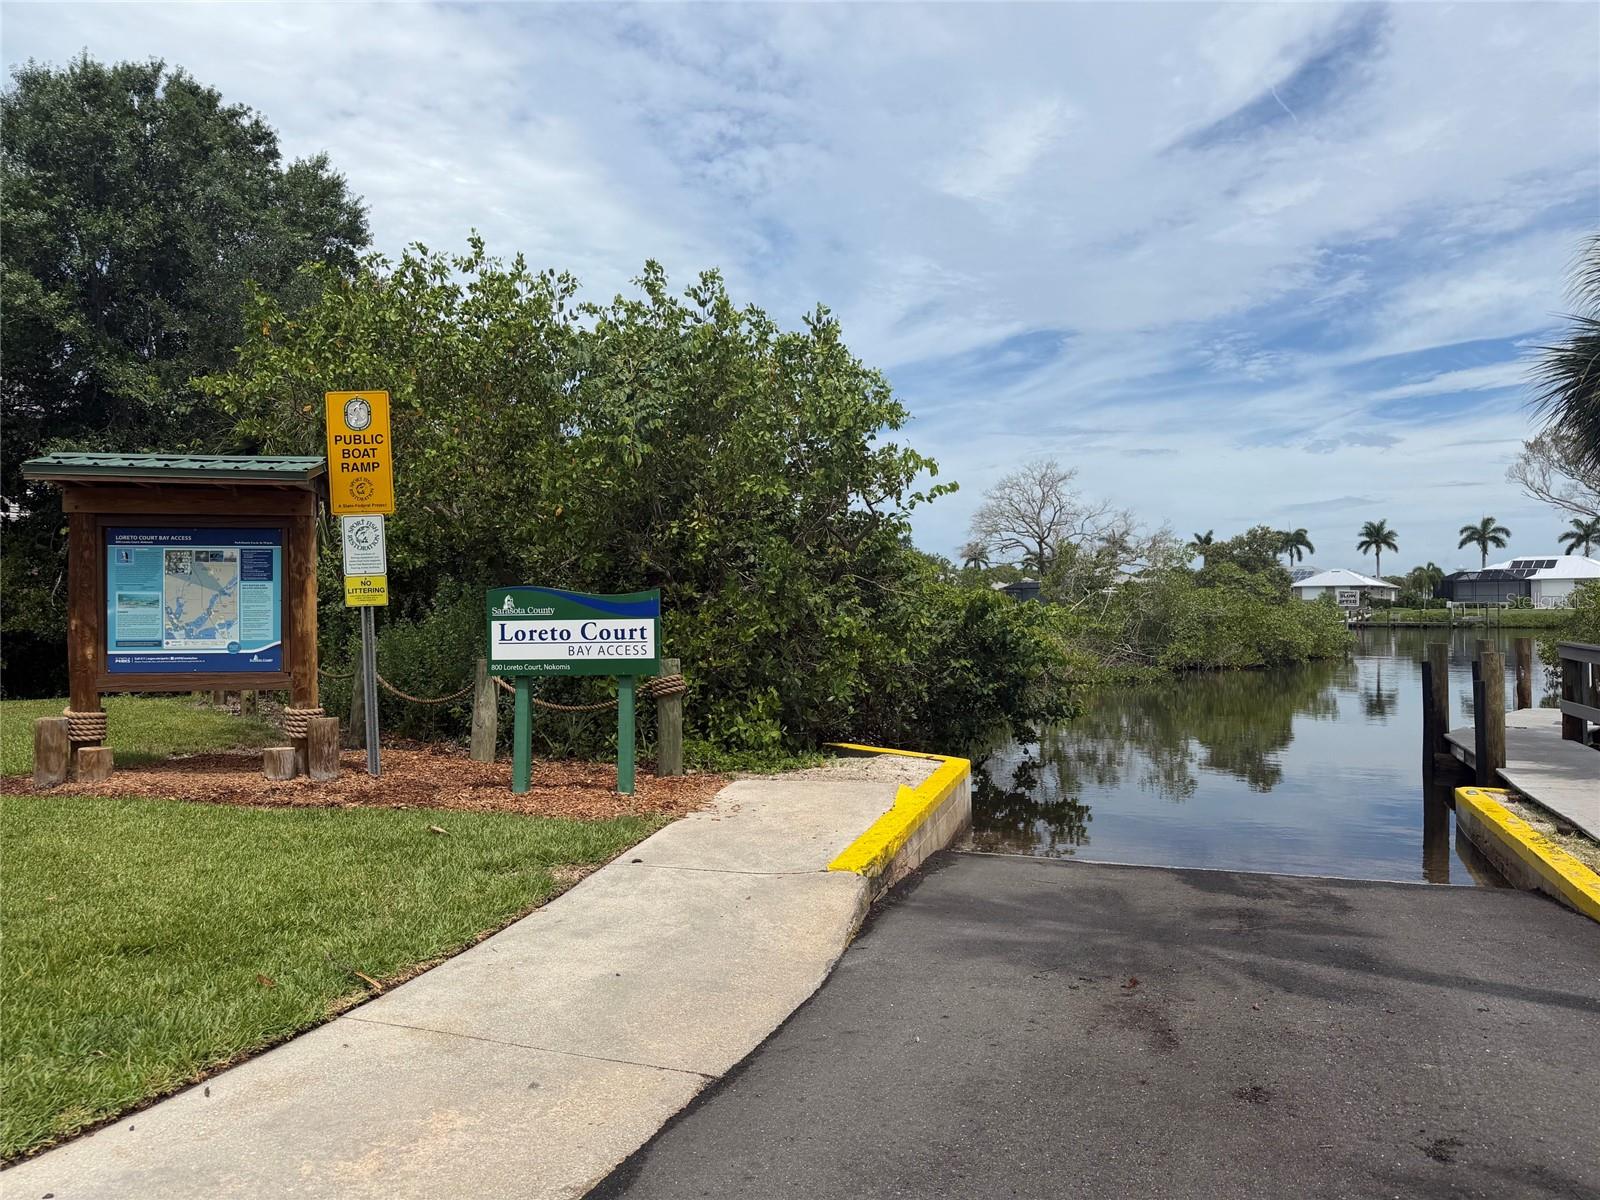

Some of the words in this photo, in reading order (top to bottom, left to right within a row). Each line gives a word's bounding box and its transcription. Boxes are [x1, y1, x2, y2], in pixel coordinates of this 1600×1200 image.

[334, 434, 384, 445] PUBLIC
[342, 448, 377, 459] BOAT
[341, 462, 380, 472] RAMP
[491, 607, 526, 615] Sarasota
[527, 606, 555, 615] County
[499, 623, 572, 641] Loreto
[580, 621, 648, 640] Court
[568, 645, 592, 656] BAY
[597, 644, 648, 656] ACCESS
